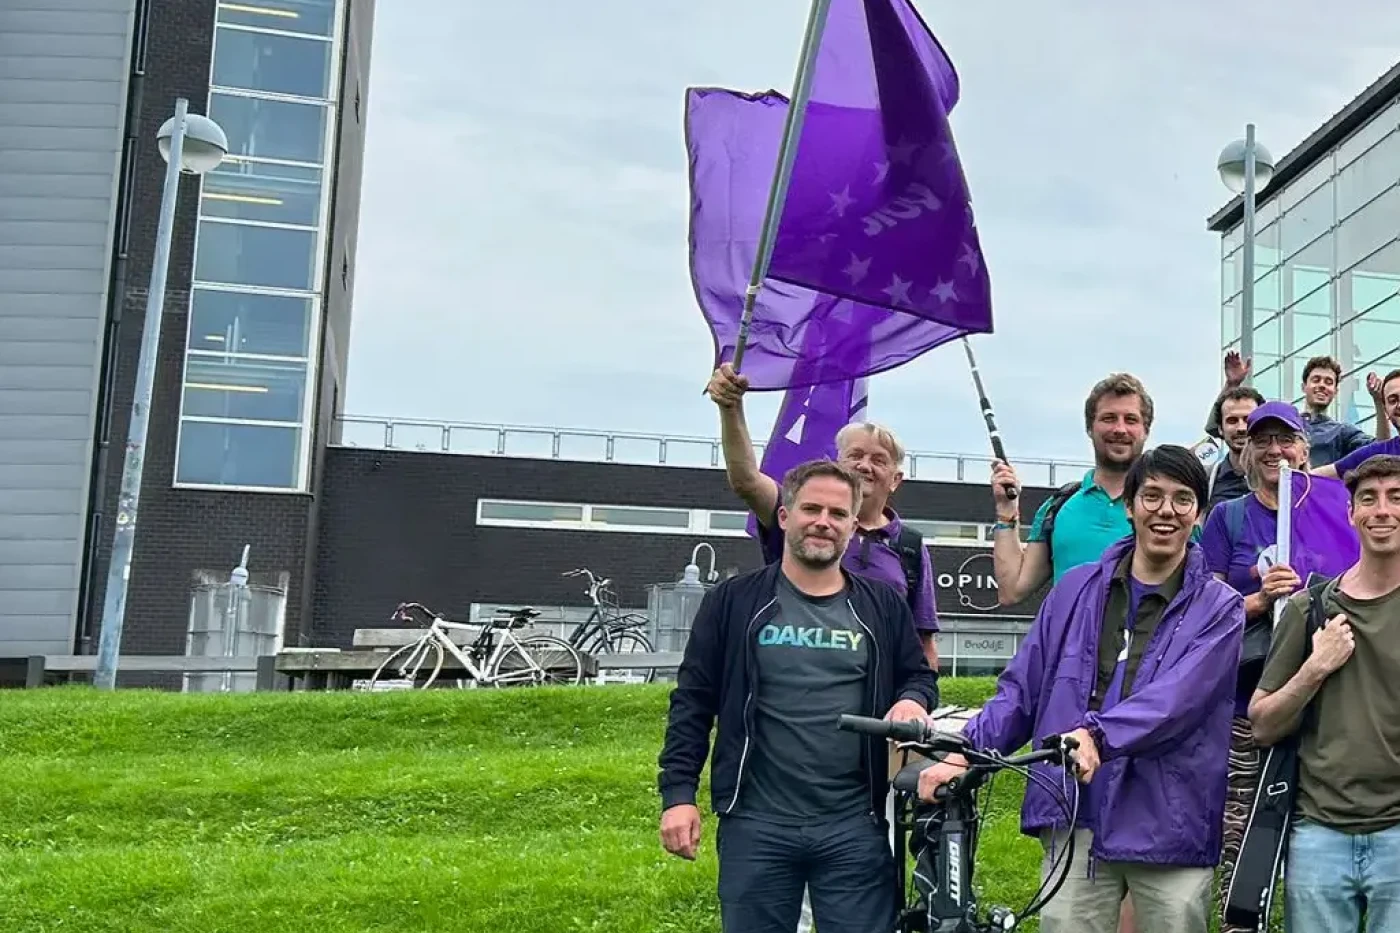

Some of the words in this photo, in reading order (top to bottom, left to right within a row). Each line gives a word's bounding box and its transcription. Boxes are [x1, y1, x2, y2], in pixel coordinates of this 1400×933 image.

[937, 573, 999, 589] OPIN
[758, 624, 864, 652] OAKLEY
[948, 840, 961, 907] GIANT
